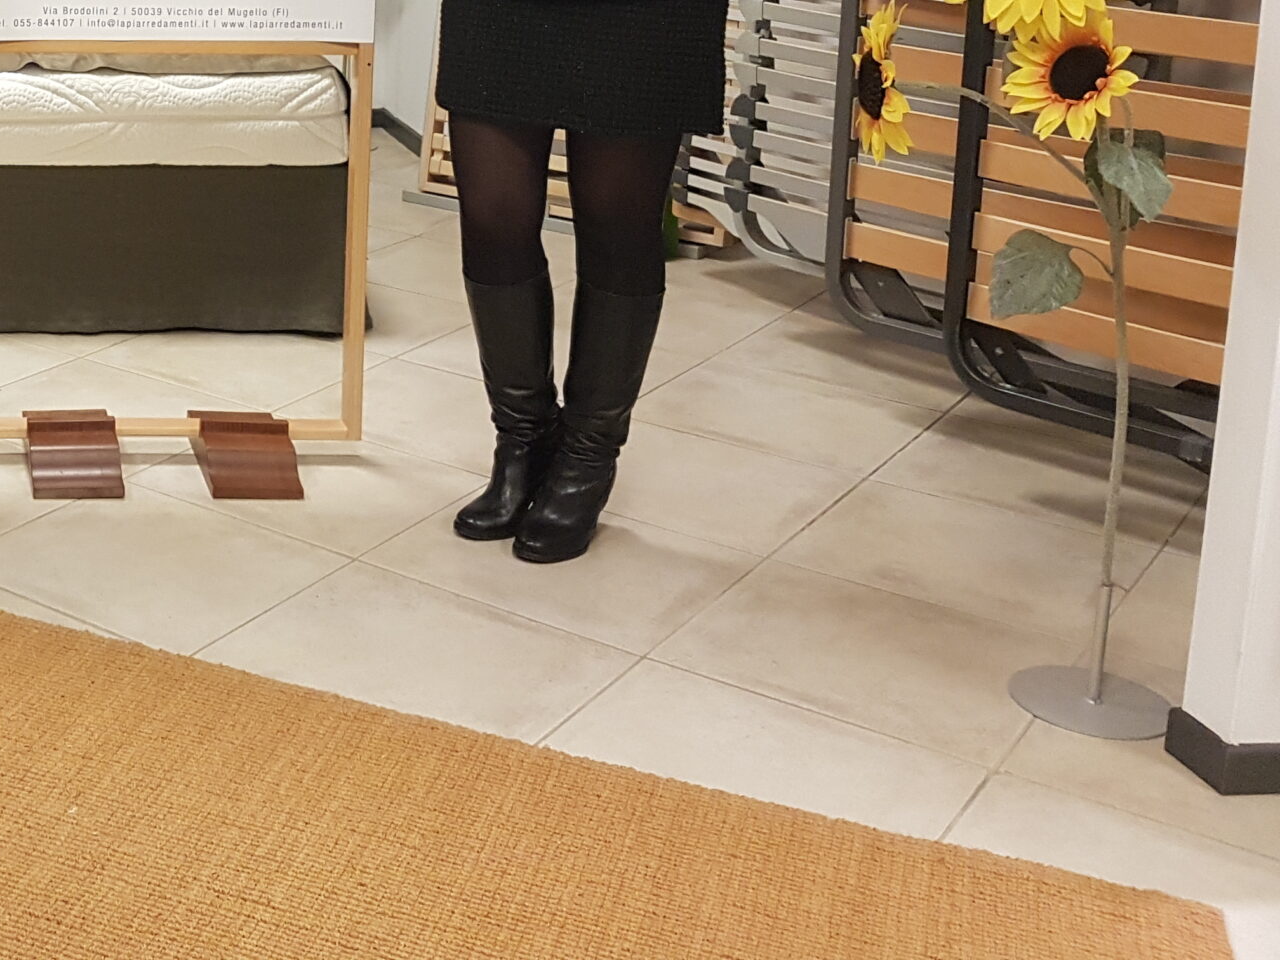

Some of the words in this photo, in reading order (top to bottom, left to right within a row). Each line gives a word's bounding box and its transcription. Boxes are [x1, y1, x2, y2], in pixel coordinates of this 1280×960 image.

[42, 6, 58, 15] Via
[62, 6, 109, 16] Brodolini
[113, 7, 119, 16] 2
[131, 7, 163, 16] 50039
[167, 7, 204, 16] Vicchio
[208, 8, 223, 16] del
[228, 8, 268, 18] Mugello
[272, 8, 290, 18] (FI)
[13, 18, 75, 28] 055-844107
[87, 19, 209, 29] info@lapiarredamenti.it
